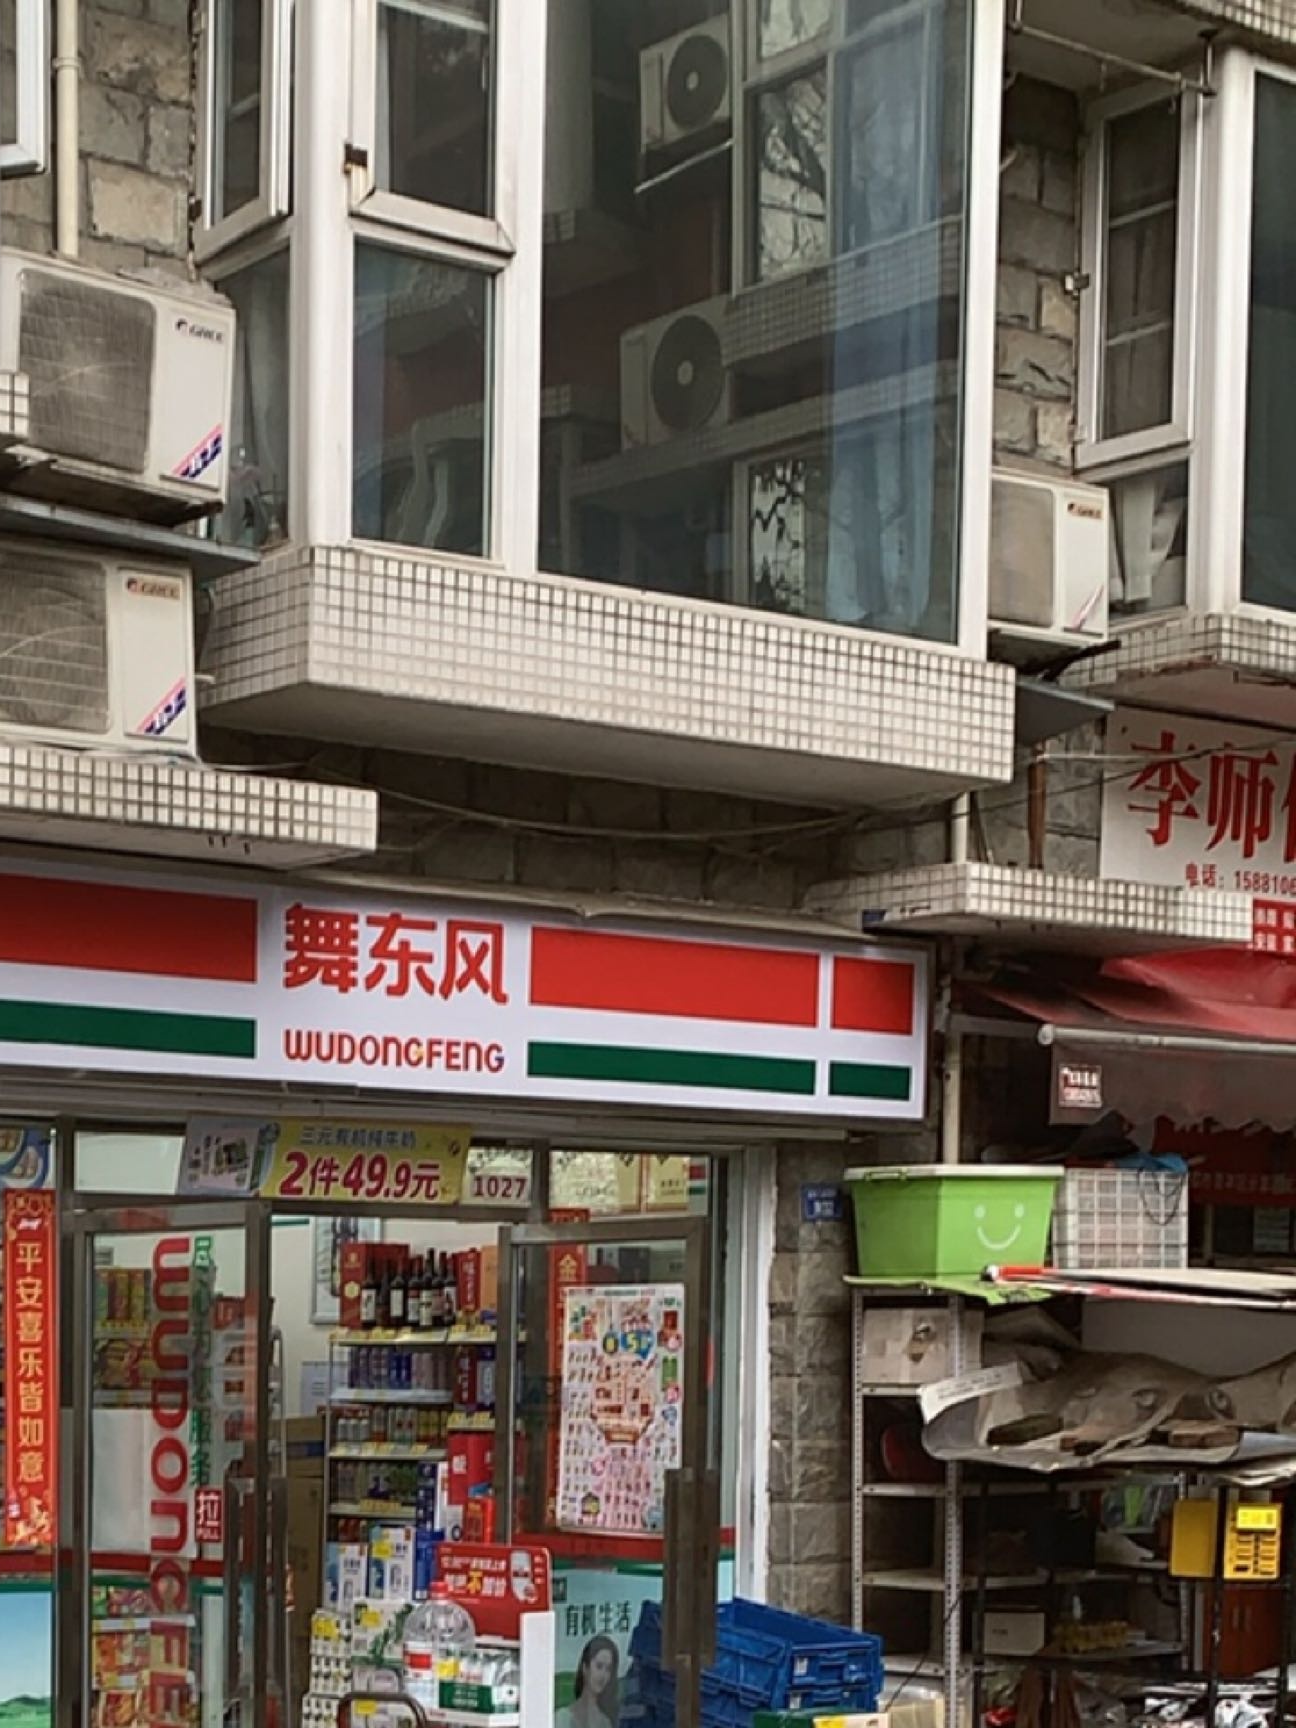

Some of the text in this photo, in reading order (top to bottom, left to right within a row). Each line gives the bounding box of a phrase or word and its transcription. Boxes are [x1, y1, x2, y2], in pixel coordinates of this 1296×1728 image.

[282, 902, 509, 1004] 舞东风
[279, 1151, 441, 1201] 2件49.9元
[473, 1175, 528, 1198] 1027
[15, 1242, 45, 1483] 平安喜乐皆如意
